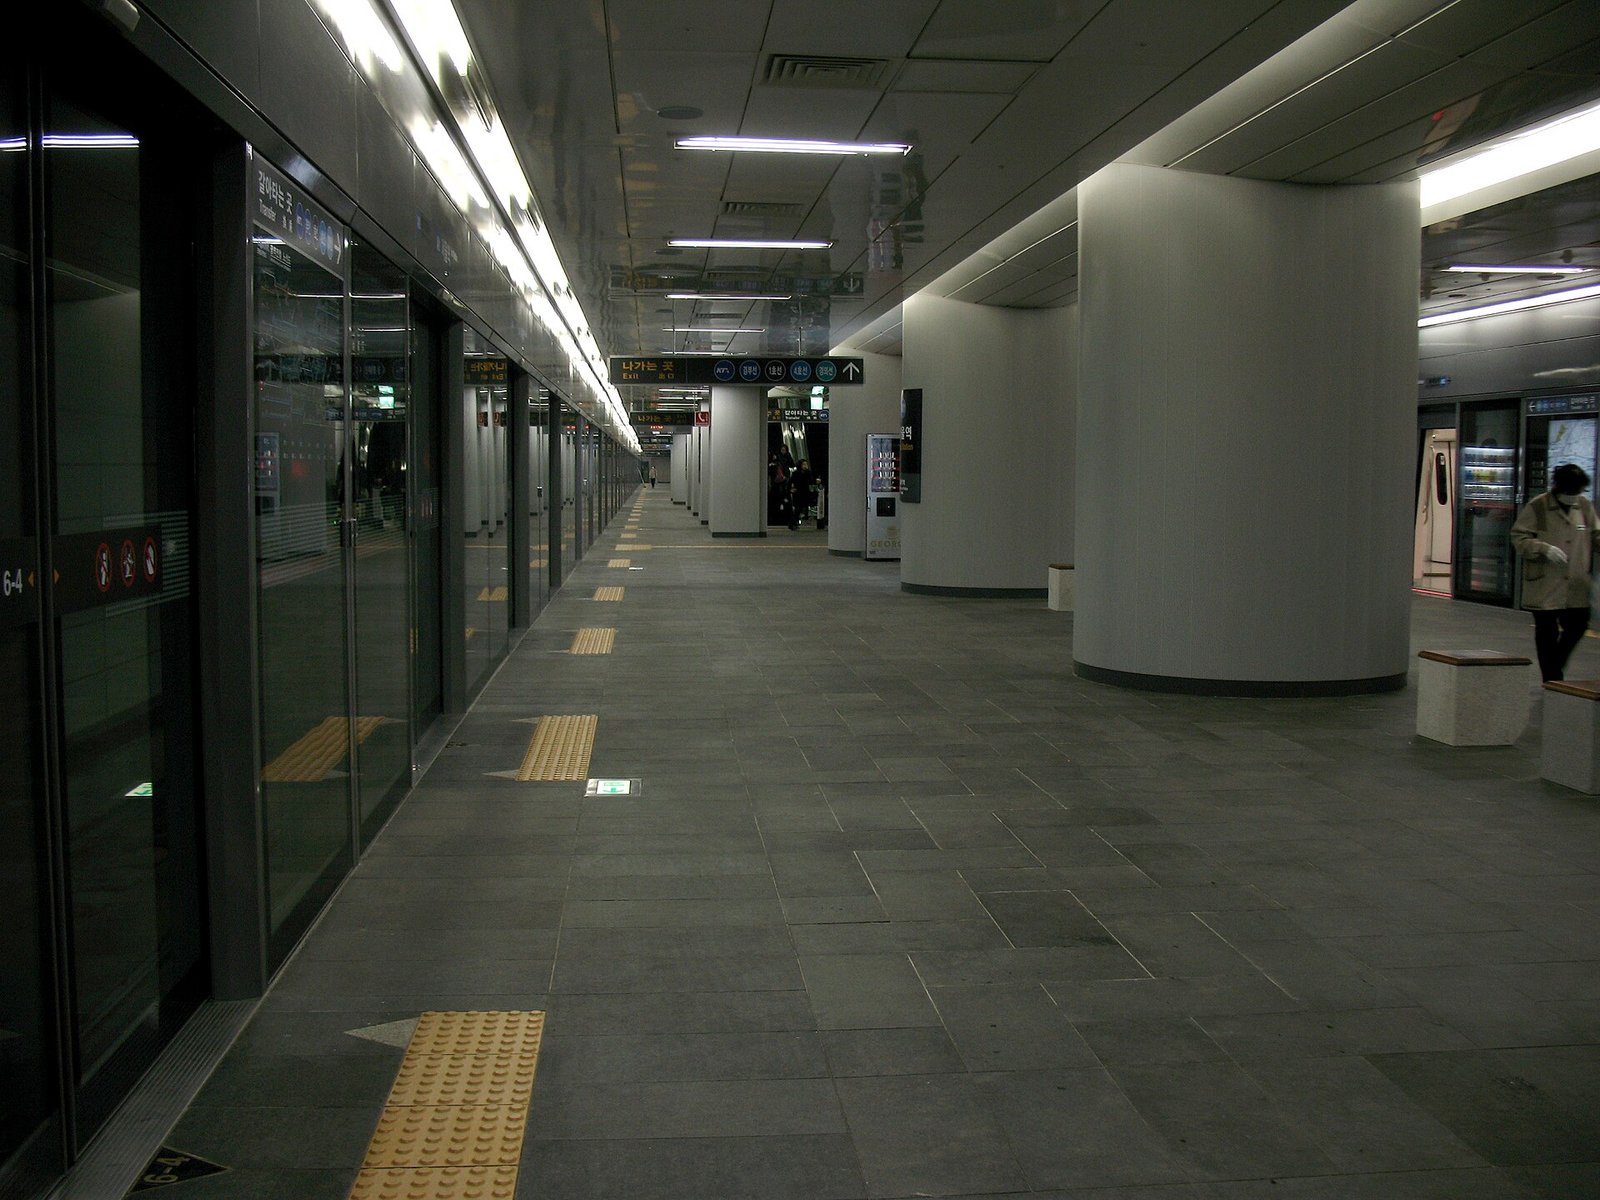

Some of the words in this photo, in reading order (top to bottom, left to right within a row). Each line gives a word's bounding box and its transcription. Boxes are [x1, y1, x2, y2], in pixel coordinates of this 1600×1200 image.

[259, 170, 284, 209] 갈아타는
[623, 361, 657, 371] 나가는
[663, 361, 674, 371] 곳
[3, 568, 22, 596] 6-4
[144, 1157, 191, 1184] 6-4
